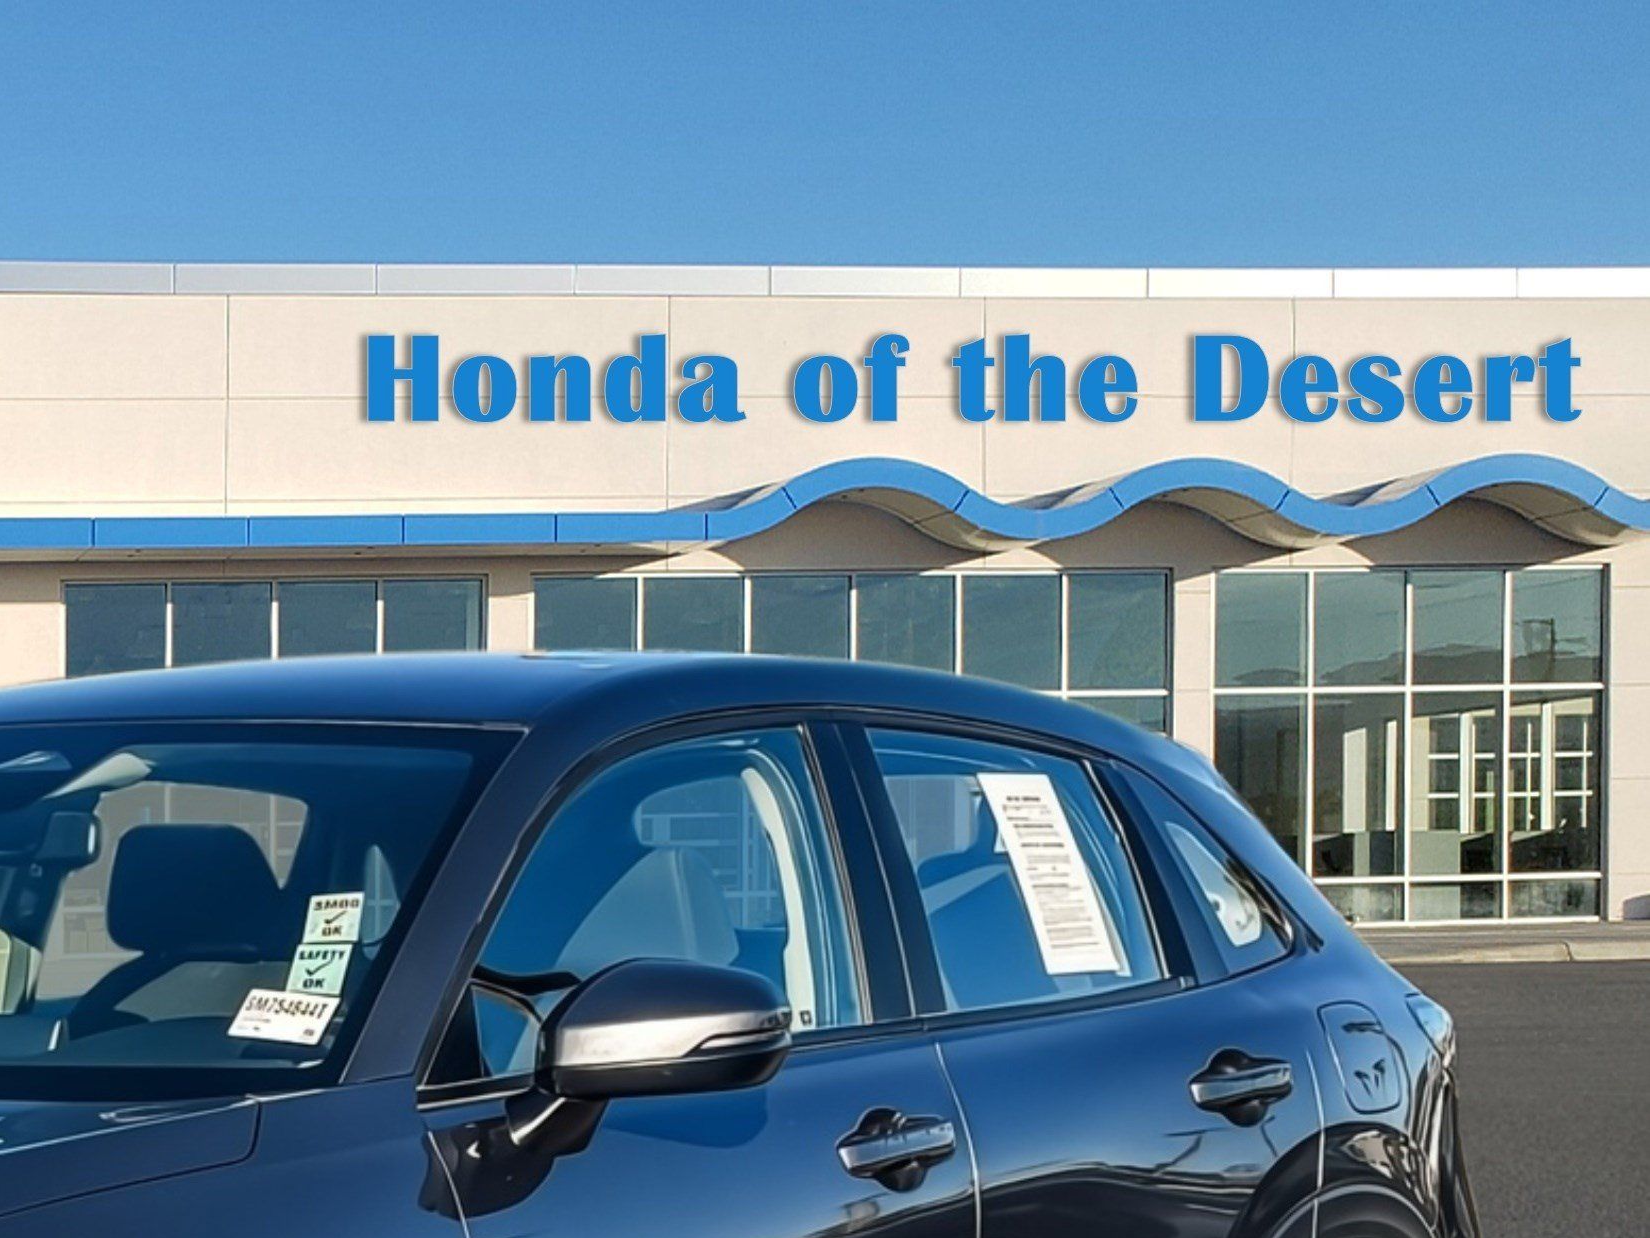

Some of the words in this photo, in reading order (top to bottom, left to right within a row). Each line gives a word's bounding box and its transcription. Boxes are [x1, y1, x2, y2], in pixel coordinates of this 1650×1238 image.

[367, 334, 747, 423] Honda
[793, 333, 911, 423] of
[952, 333, 1139, 423] the
[1194, 334, 1583, 423] Desert
[322, 926, 343, 937] OK
[299, 950, 346, 961] SAFETY
[303, 978, 326, 989] OK
